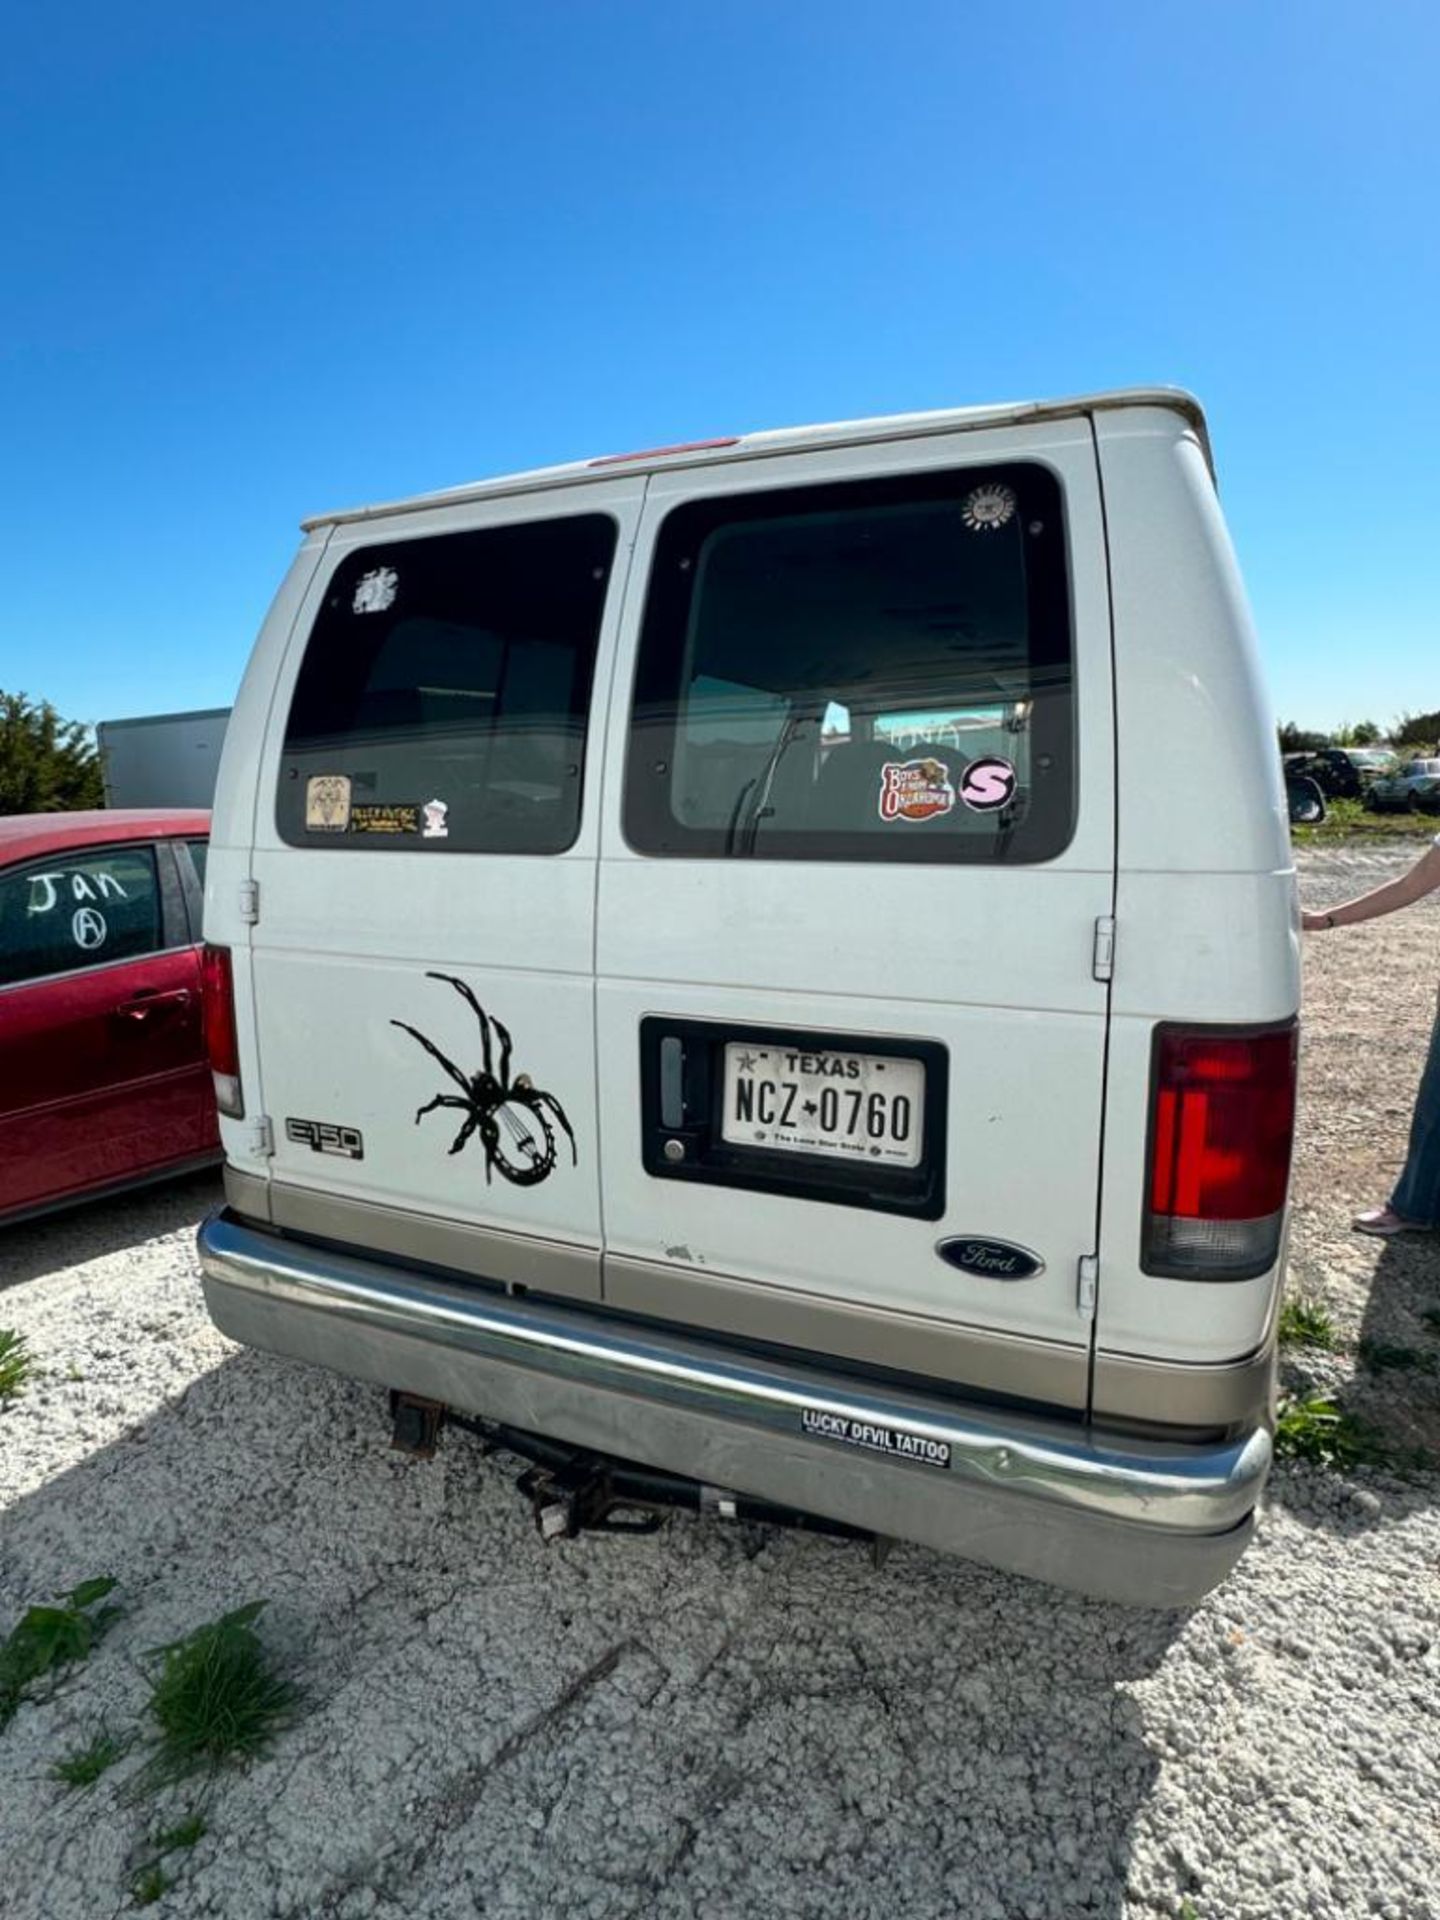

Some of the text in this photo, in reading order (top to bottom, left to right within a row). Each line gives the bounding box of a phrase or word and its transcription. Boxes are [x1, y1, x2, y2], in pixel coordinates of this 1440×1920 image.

[961, 765, 1012, 802] S
[786, 1054, 860, 1079] TEXAS
[286, 1120, 361, 1151] E150
[961, 1244, 1017, 1272] Ford
[802, 1409, 850, 1436] LUCKY
[851, 1423, 893, 1448] DEVIL
[895, 1433, 949, 1461] TATTOO
